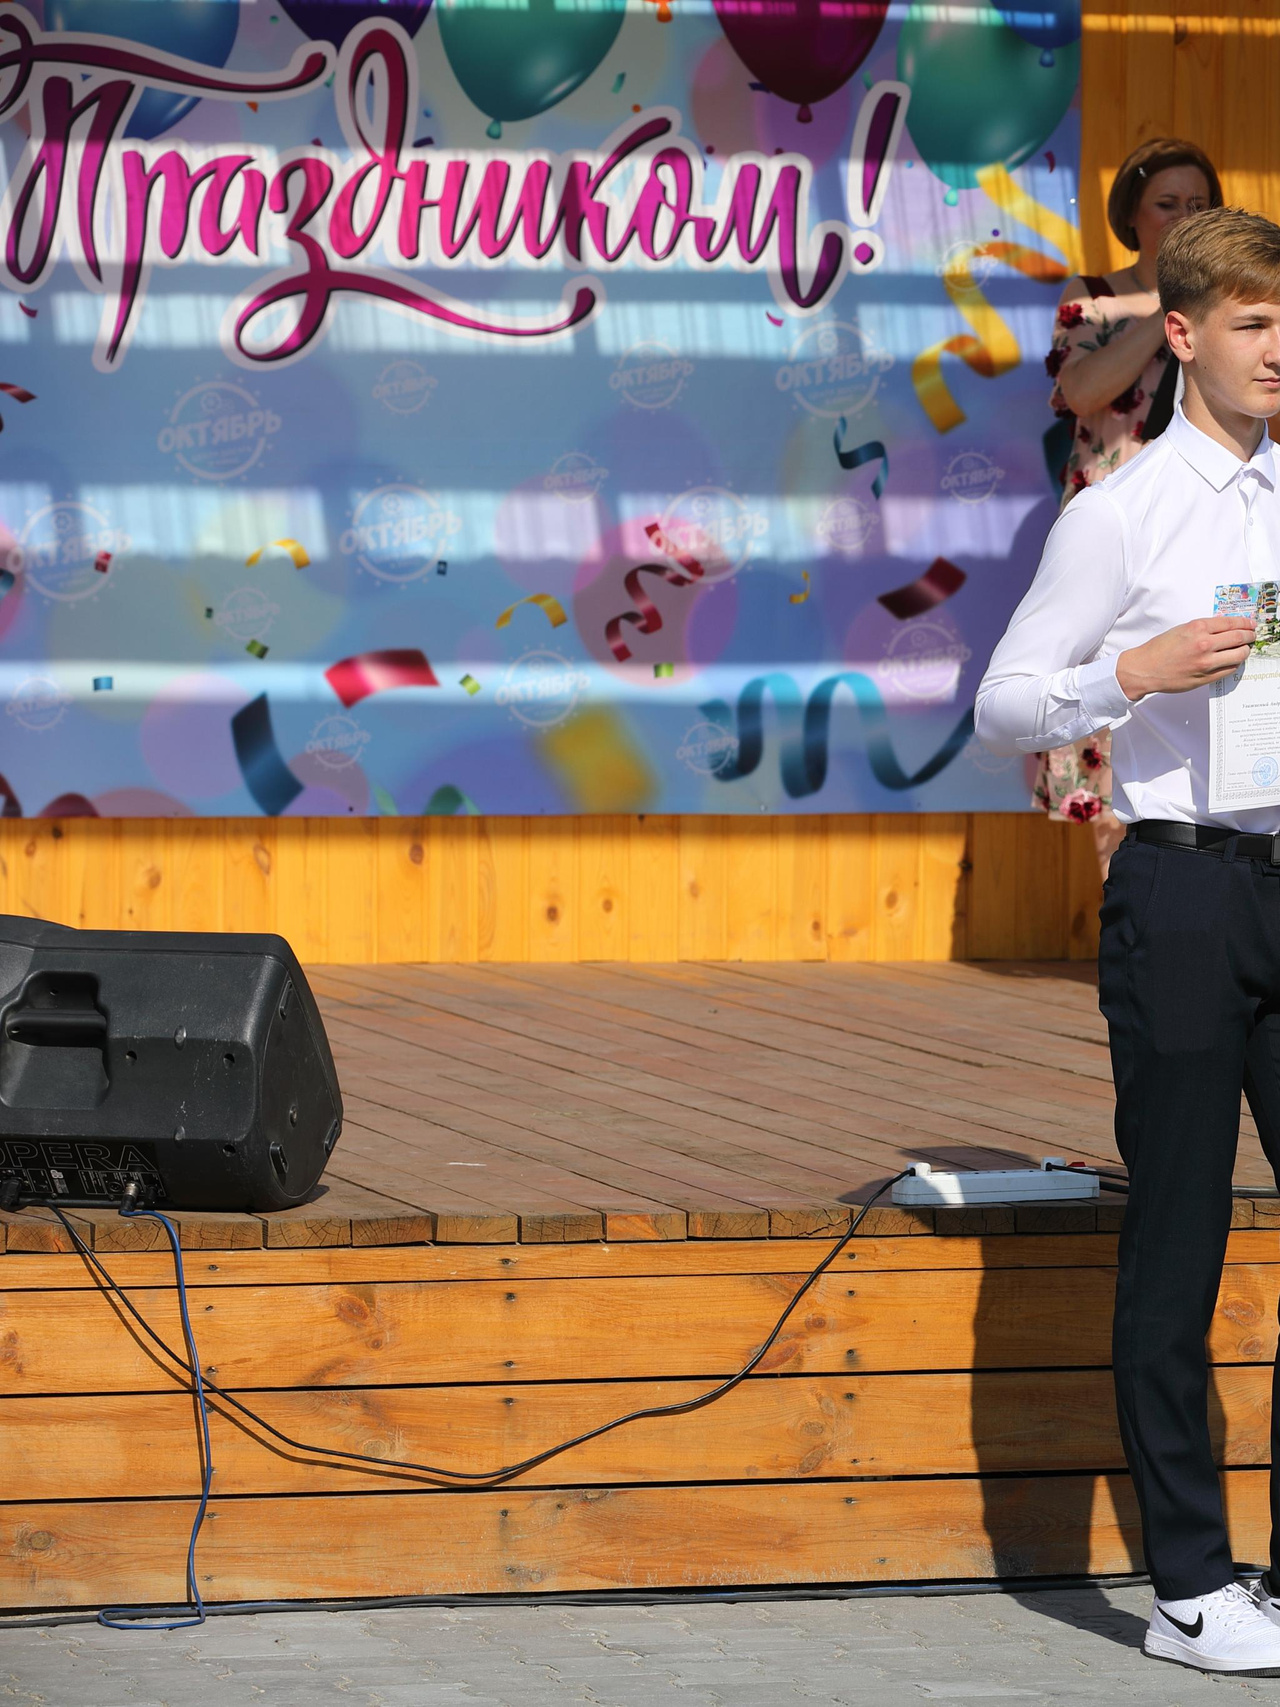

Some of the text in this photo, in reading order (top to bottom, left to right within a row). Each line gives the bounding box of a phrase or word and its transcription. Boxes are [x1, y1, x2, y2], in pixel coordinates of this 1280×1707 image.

[2, 28, 902, 363] Праздником!
[776, 348, 895, 391] ОКТЯБРЬ
[157, 409, 282, 453] ОКТЯБРЬ
[339, 509, 463, 555] ОКТЯБРЬ
[648, 511, 769, 557] ОКТЯБРЬ
[0, 1141, 158, 1172] PERA
